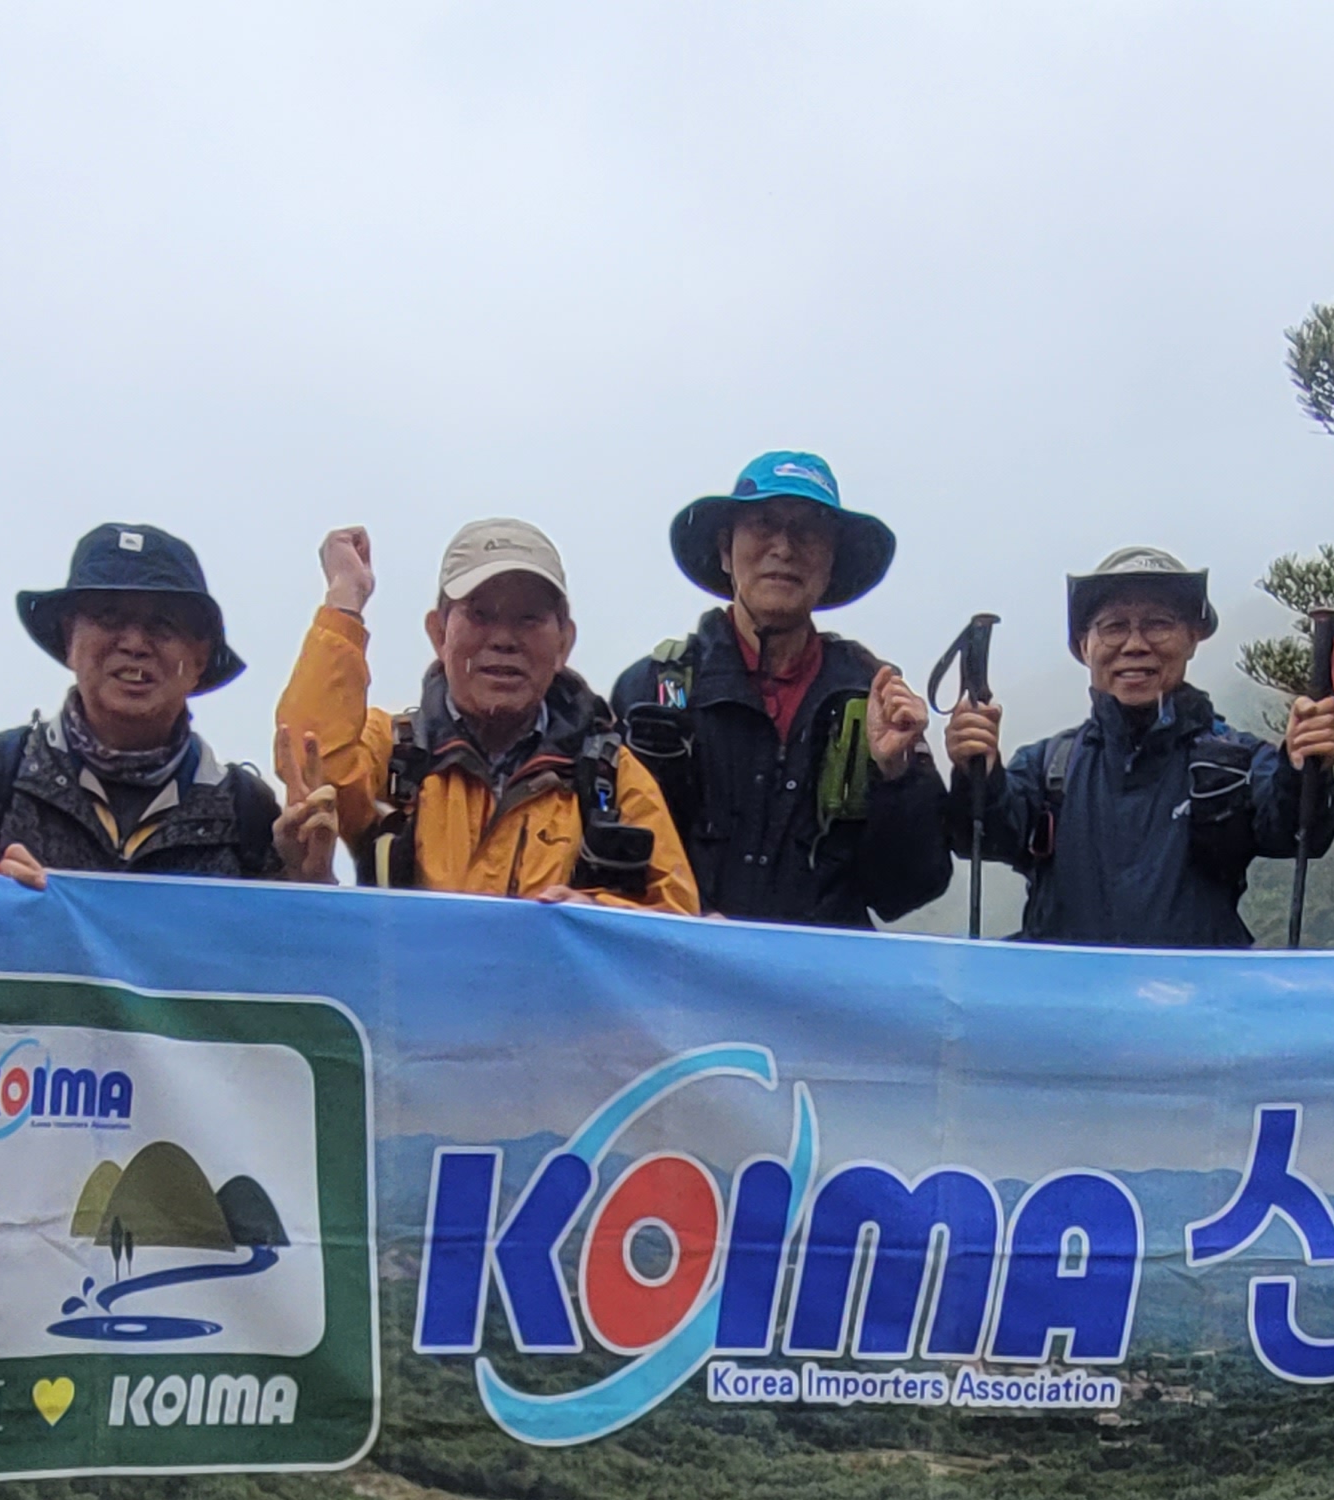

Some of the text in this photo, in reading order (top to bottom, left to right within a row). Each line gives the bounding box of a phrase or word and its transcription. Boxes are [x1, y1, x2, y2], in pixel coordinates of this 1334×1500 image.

[414, 1147, 1144, 1363] KOIMA
[108, 1373, 300, 1427] KOIMA
[711, 1367, 1117, 1404] Korea Importers Association
